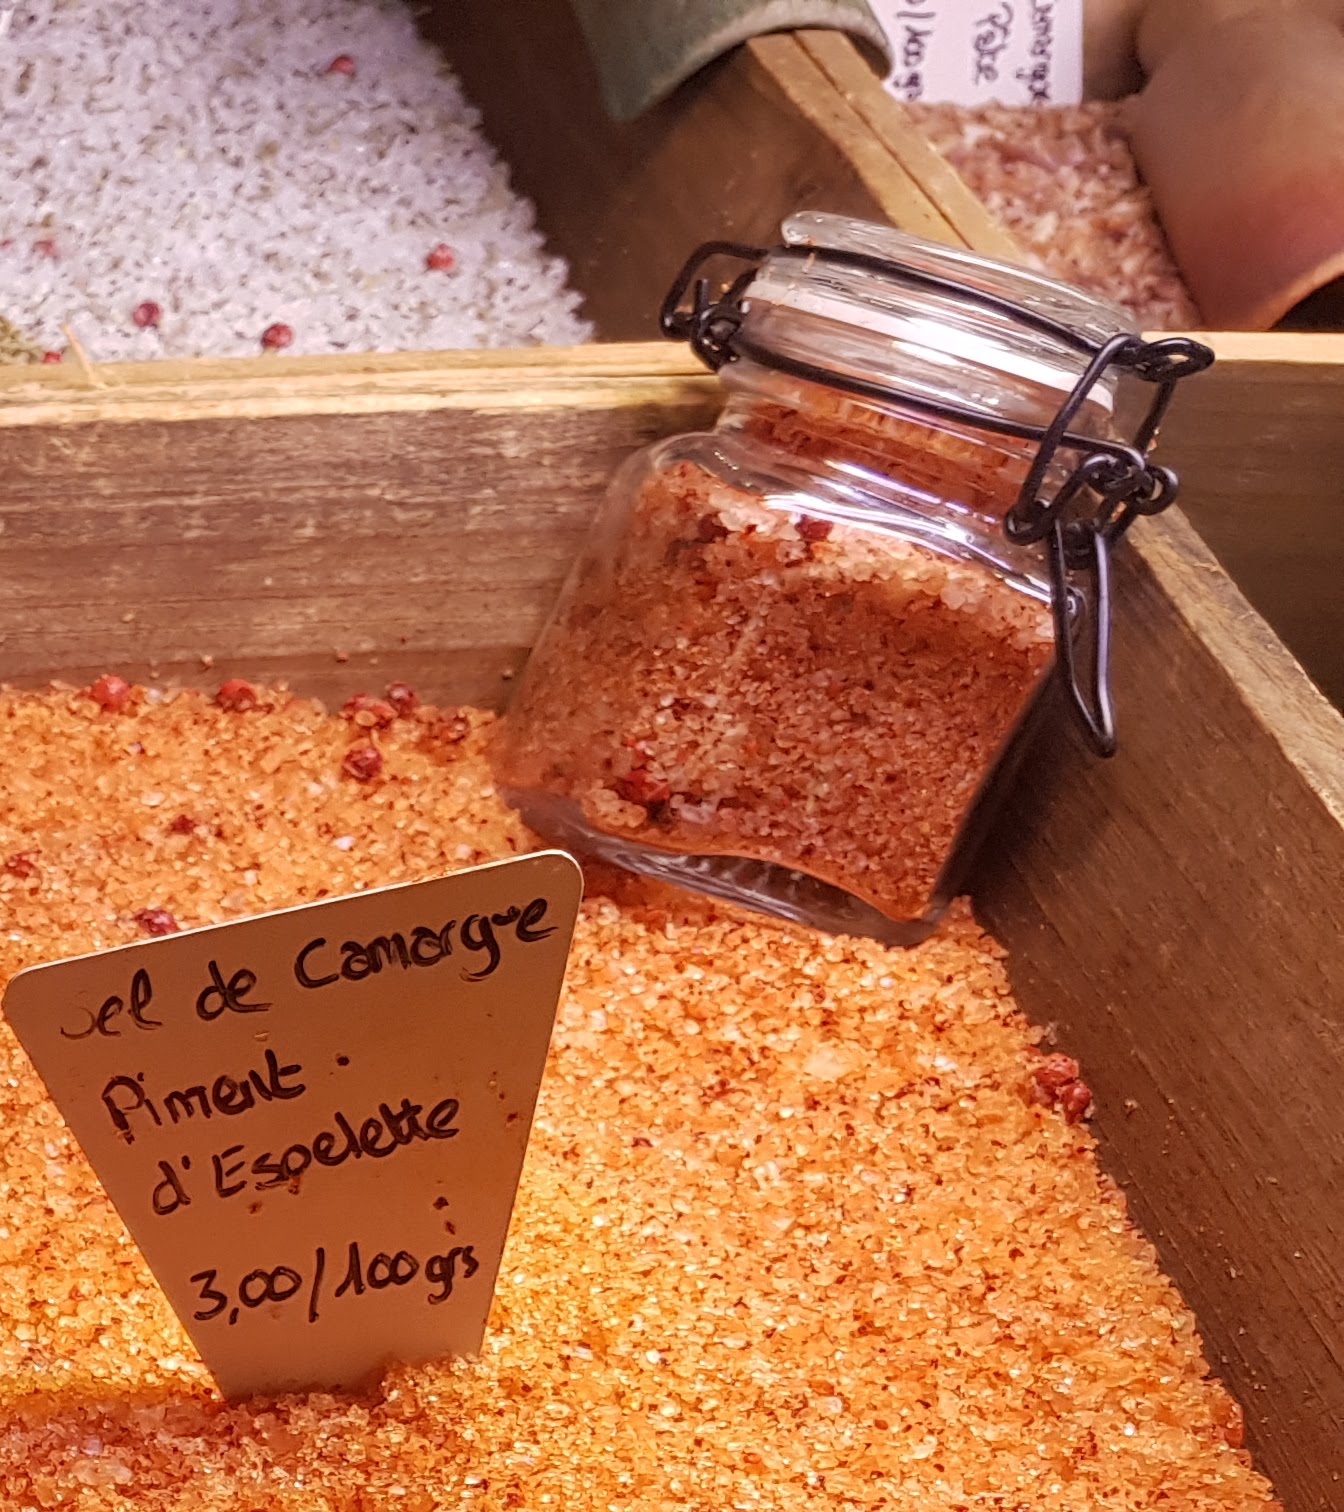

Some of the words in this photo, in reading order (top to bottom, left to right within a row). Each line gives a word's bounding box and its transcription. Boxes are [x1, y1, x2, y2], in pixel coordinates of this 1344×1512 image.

[195, 959, 273, 1022] de
[293, 896, 560, 984] Camargue
[101, 1048, 307, 1145] Piment
